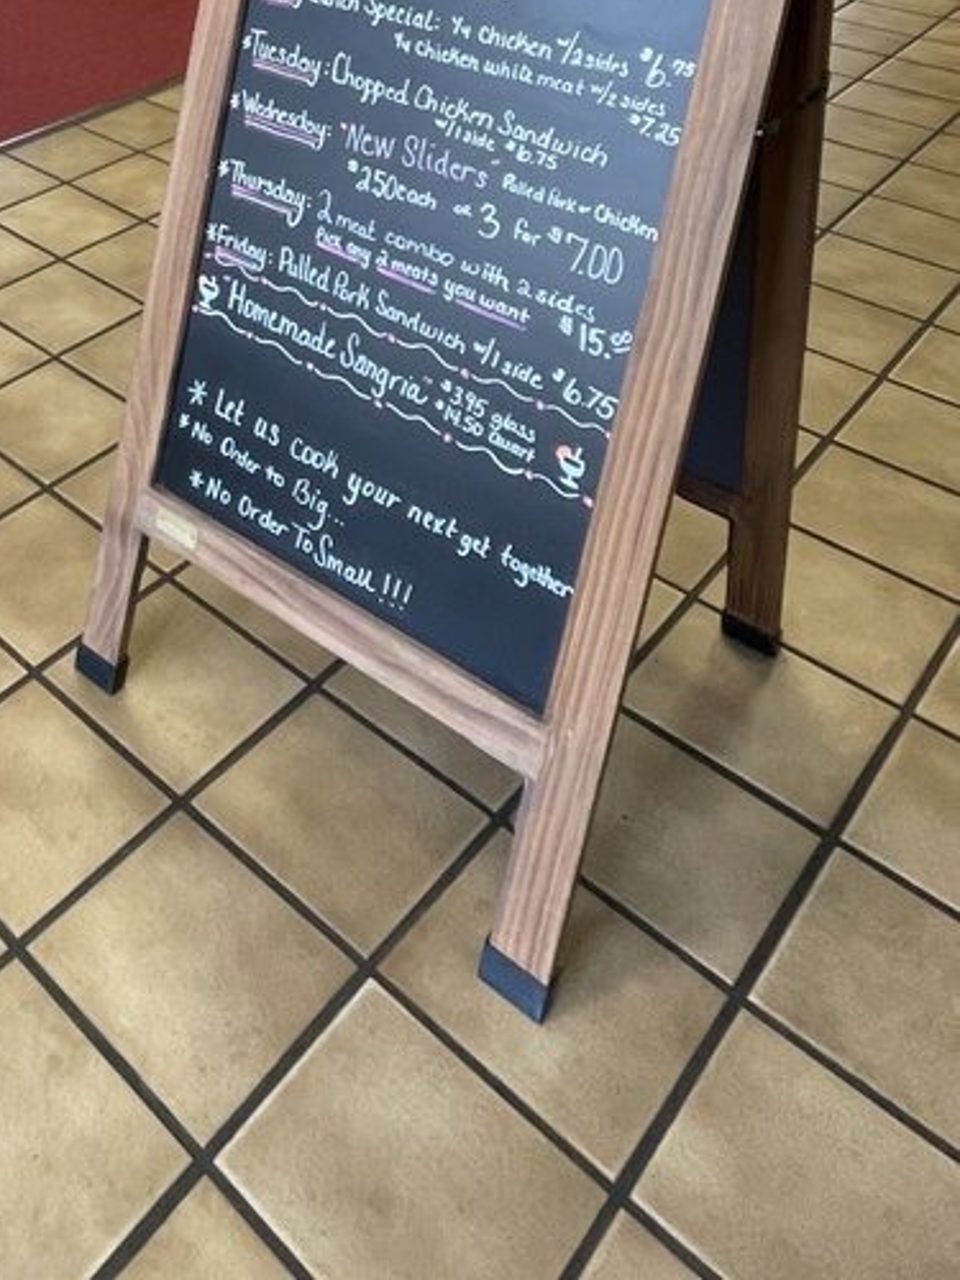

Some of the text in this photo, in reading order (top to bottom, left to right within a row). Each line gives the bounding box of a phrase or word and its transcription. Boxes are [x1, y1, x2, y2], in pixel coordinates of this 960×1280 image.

[250, 27, 608, 169] Tuesday: Chopped Chicken Sandwich
[537, 73, 584, 96] meat
[317, 189, 333, 224] 2
[336, 213, 377, 242] meat
[384, 230, 455, 268] combo
[460, 260, 510, 293] with
[517, 278, 533, 300] 2
[535, 289, 595, 324] sides
[477, 202, 501, 239] 3
[278, 245, 331, 293] Pulled
[332, 271, 372, 311] Pork
[375, 289, 466, 354] Sandwich
[501, 361, 544, 390] side
[390, 260, 439, 287] meats
[442, 278, 477, 302] you
[479, 293, 531, 323] want
[191, 421, 213, 445] No
[219, 436, 261, 474] Order
[264, 465, 285, 488] to
[214, 387, 245, 427] Let
[253, 416, 280, 447] us
[341, 472, 401, 506] your
[406, 504, 459, 539] next
[456, 533, 491, 559] get
[500, 544, 574, 598] together
[204, 477, 232, 505] No
[237, 494, 289, 536] Order
[292, 521, 314, 554] To
